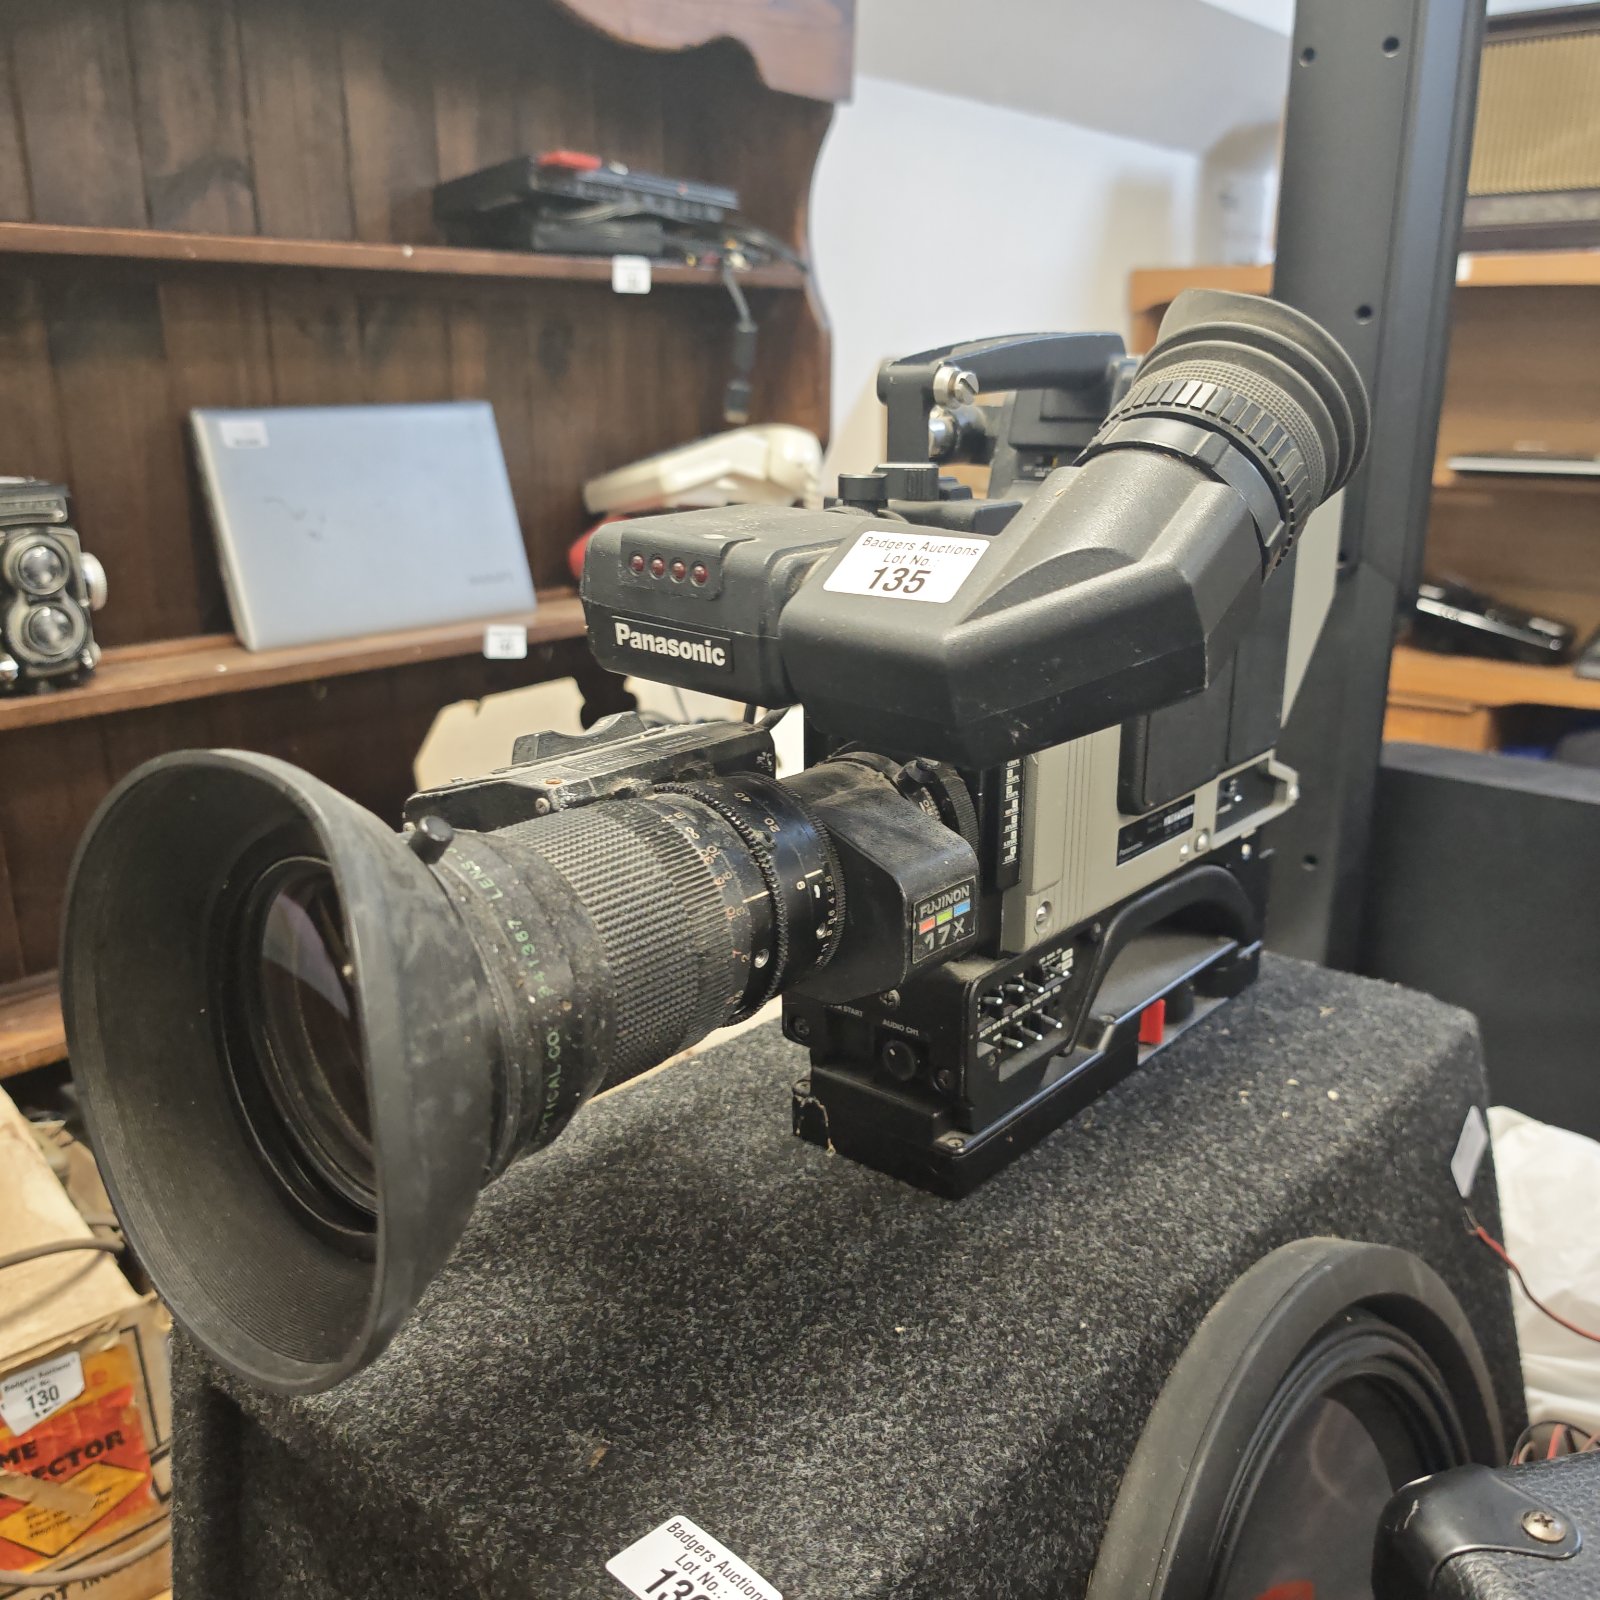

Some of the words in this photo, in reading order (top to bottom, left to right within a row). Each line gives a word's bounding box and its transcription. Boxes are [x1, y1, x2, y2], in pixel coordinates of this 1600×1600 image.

[862, 536, 917, 551] Badgers
[920, 541, 980, 556] Auctions
[883, 552, 907, 565] Lot
[868, 566, 932, 594] 135
[614, 622, 727, 668] Panasonic
[764, 817, 781, 833] 20
[920, 884, 970, 919] FUJINON
[881, 1019, 905, 1032] AUDIO
[26, 1385, 60, 1410] 130
[666, 1522, 716, 1564] Badgers
[714, 1560, 769, 1600] Auction
[675, 1553, 701, 1576] Lot
